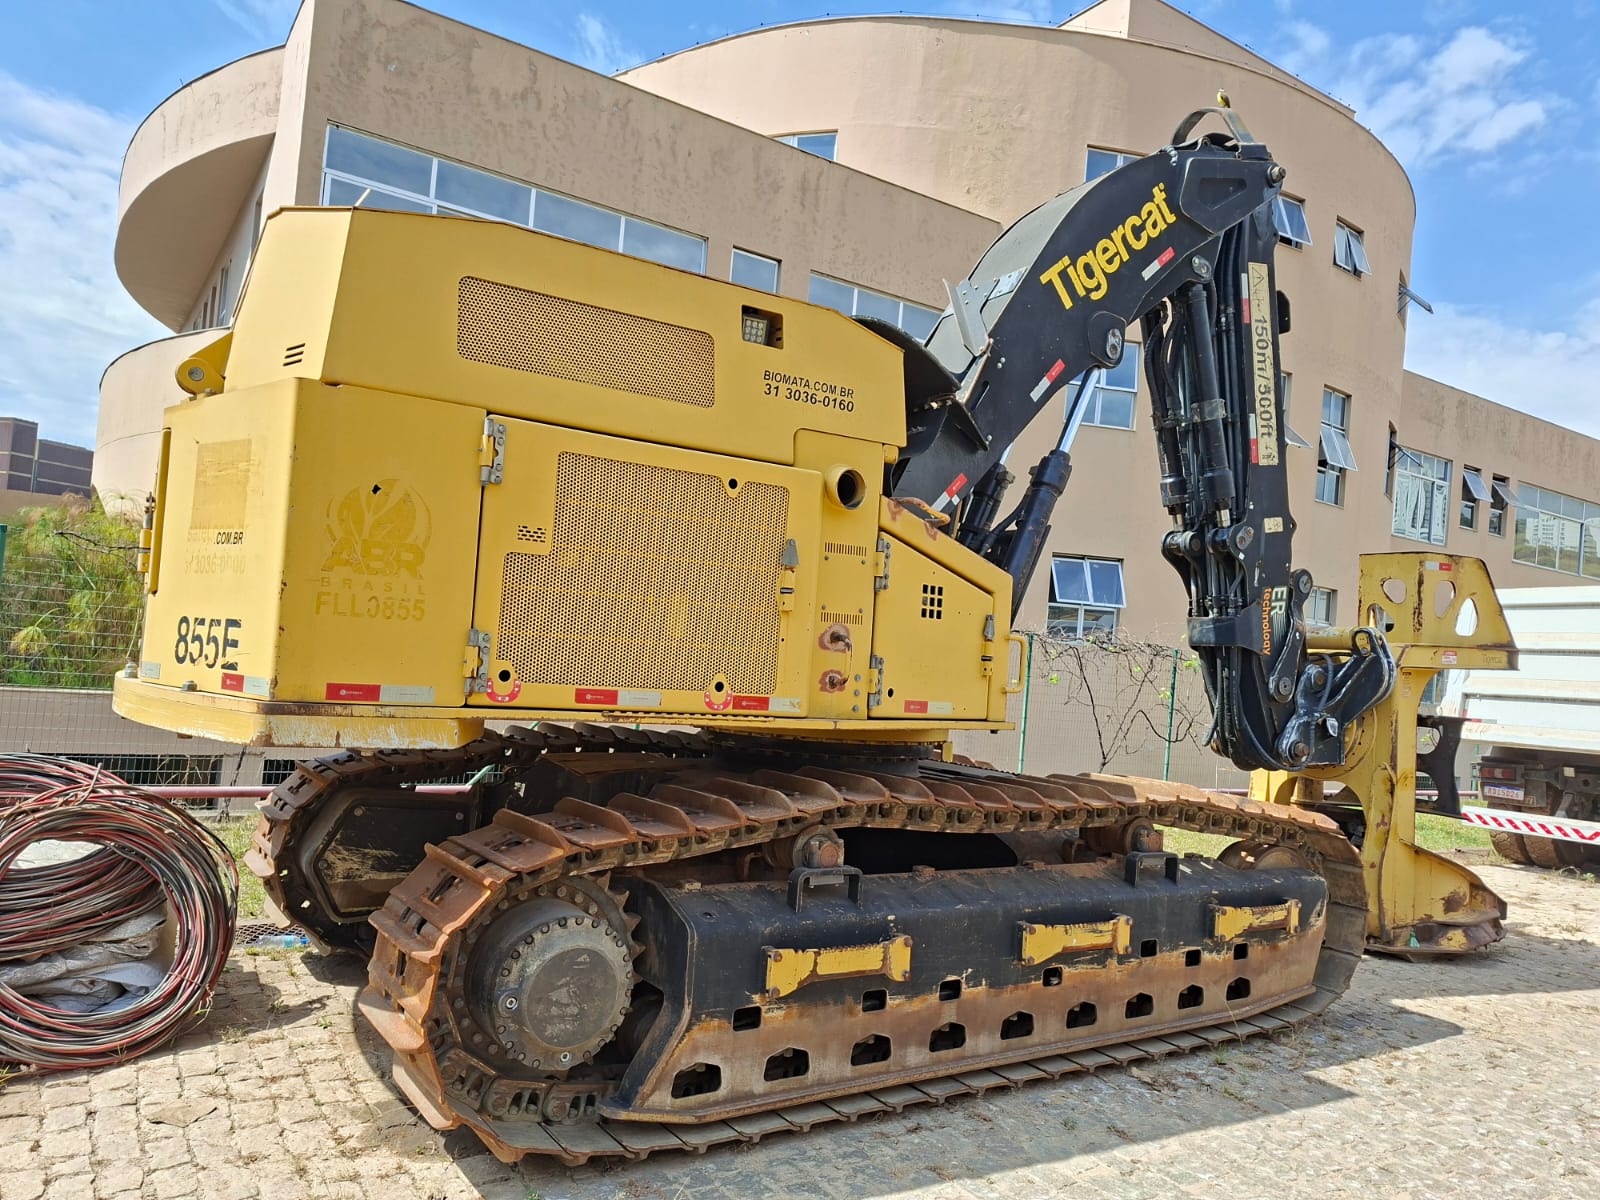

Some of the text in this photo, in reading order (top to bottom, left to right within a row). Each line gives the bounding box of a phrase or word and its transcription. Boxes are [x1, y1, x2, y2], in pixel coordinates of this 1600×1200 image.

[1039, 182, 1177, 310] Tigercat
[763, 369, 855, 399] BIOMATA.COM.BR
[763, 382, 855, 413] 31 3036-0160
[320, 536, 425, 580] ABR
[319, 576, 426, 595] BRASIL
[1270, 586, 1287, 616] ER
[174, 615, 243, 672] 855E
